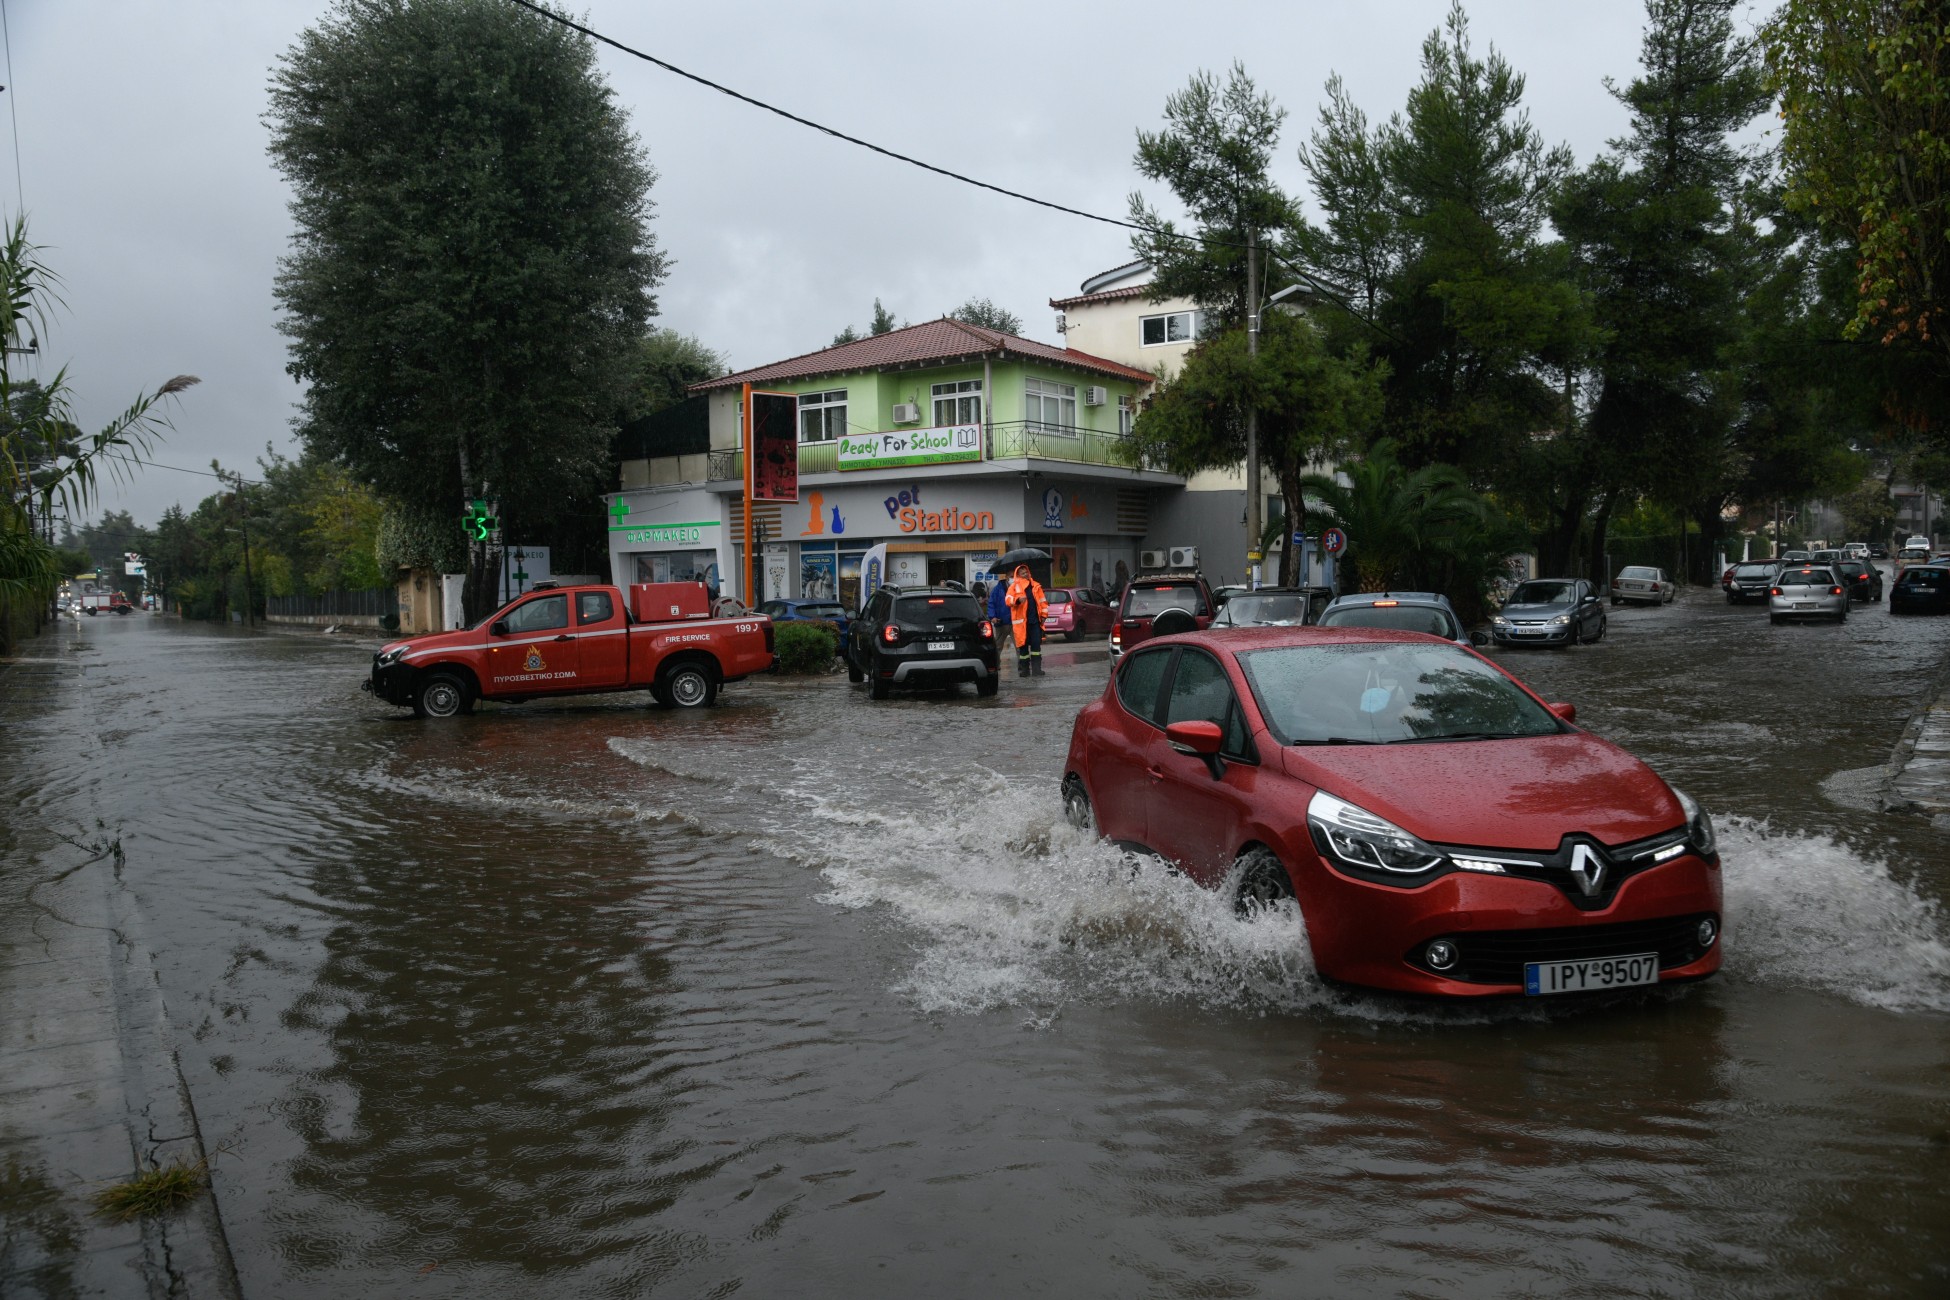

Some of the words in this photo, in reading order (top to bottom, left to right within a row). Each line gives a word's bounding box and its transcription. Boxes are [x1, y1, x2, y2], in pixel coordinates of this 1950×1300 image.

[840, 438, 879, 457] Ready
[883, 435, 908, 453] For
[910, 429, 953, 450] School
[840, 460, 871, 469] ΔΗΜΟΤΙΚΟ
[875, 458, 907, 467] ΓΥΜΝΑΣΙΟ
[884, 484, 920, 520] pet
[899, 506, 994, 533] Station
[626, 528, 701, 543] ΦΑΡΜΑΚΕΙΟ
[889, 571, 918, 579] Profine
[735, 624, 752, 633] 199
[665, 635, 681, 643] FIRE
[682, 633, 711, 642] SERVICE
[493, 672, 553, 683] ΠΥΡΟΣΒΕΣΤΙΚΟ
[554, 671, 577, 679] ΣΩΜΑ
